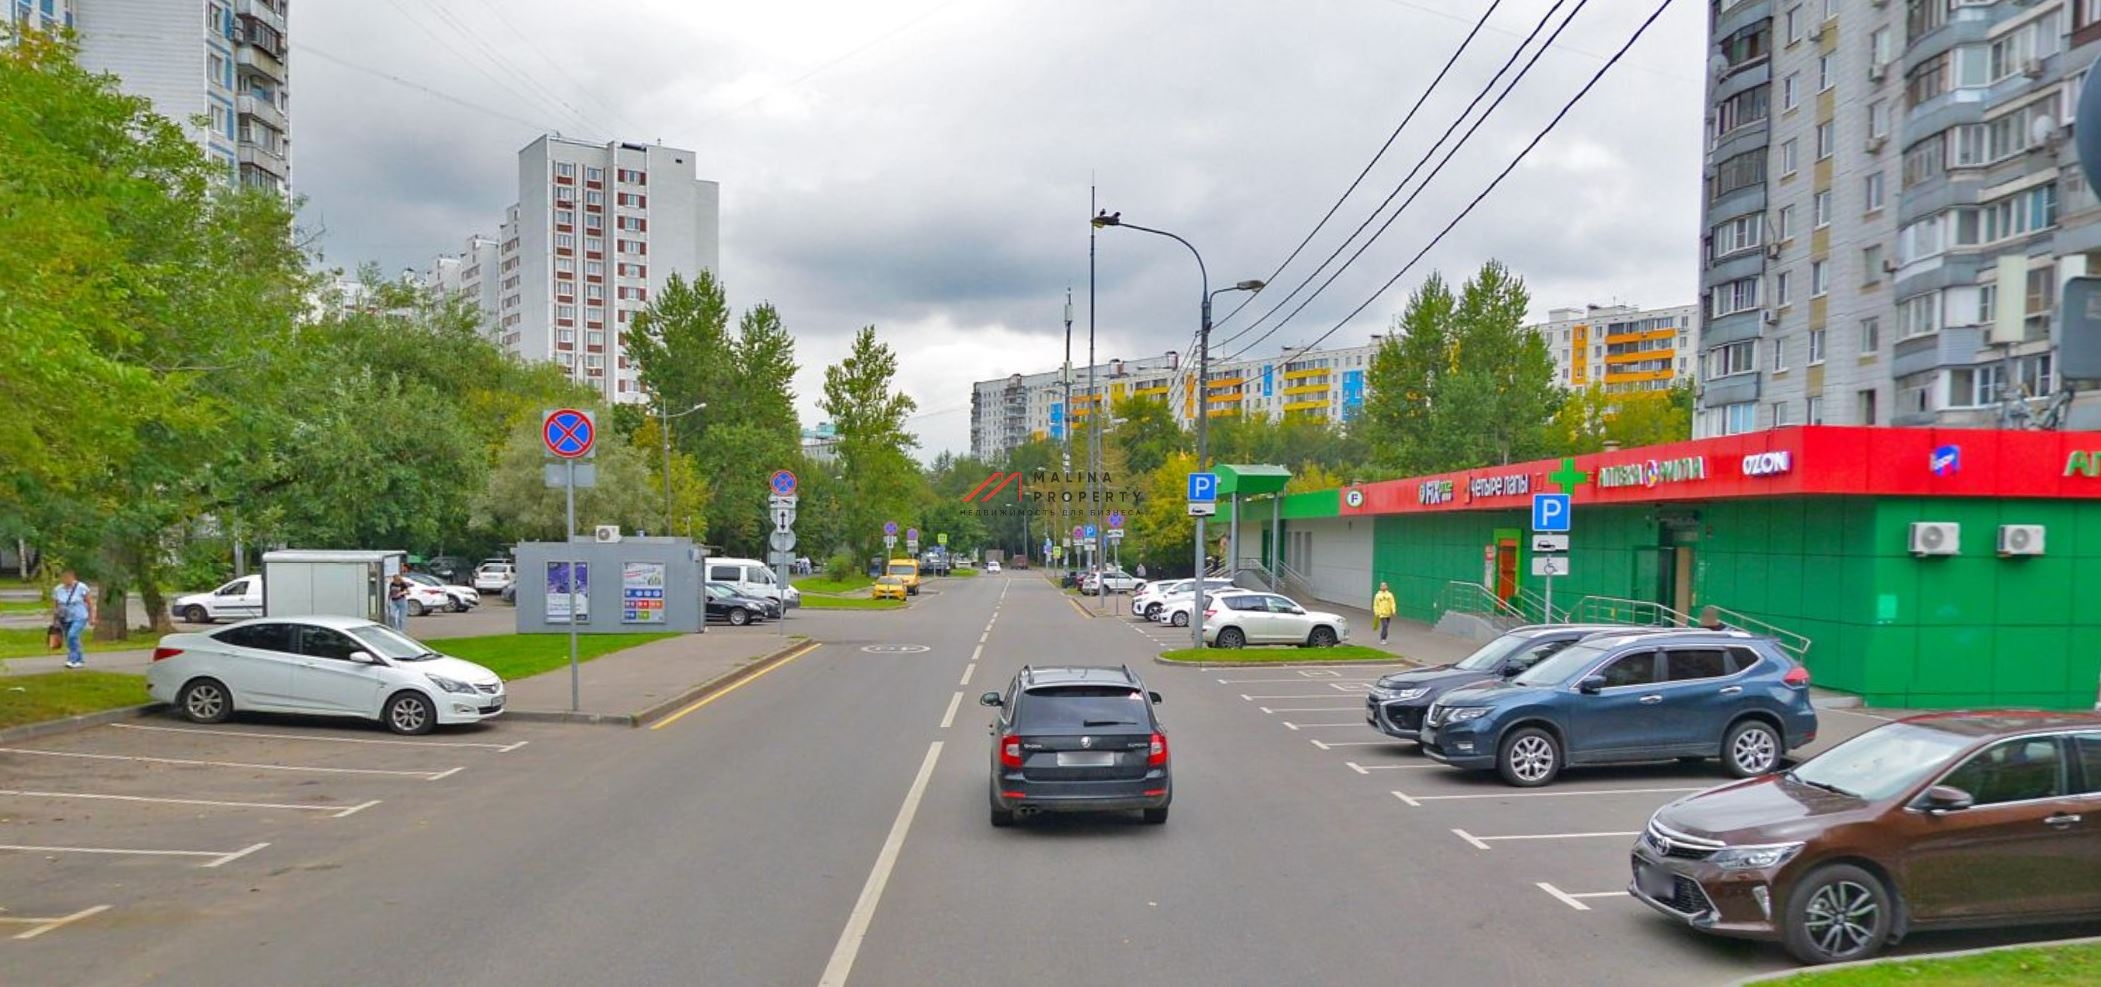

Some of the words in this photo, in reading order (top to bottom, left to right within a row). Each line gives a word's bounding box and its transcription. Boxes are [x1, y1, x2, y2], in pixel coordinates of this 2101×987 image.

[1742, 451, 1791, 476] OZON
[1195, 477, 1210, 498] P
[1542, 499, 1562, 526] P
